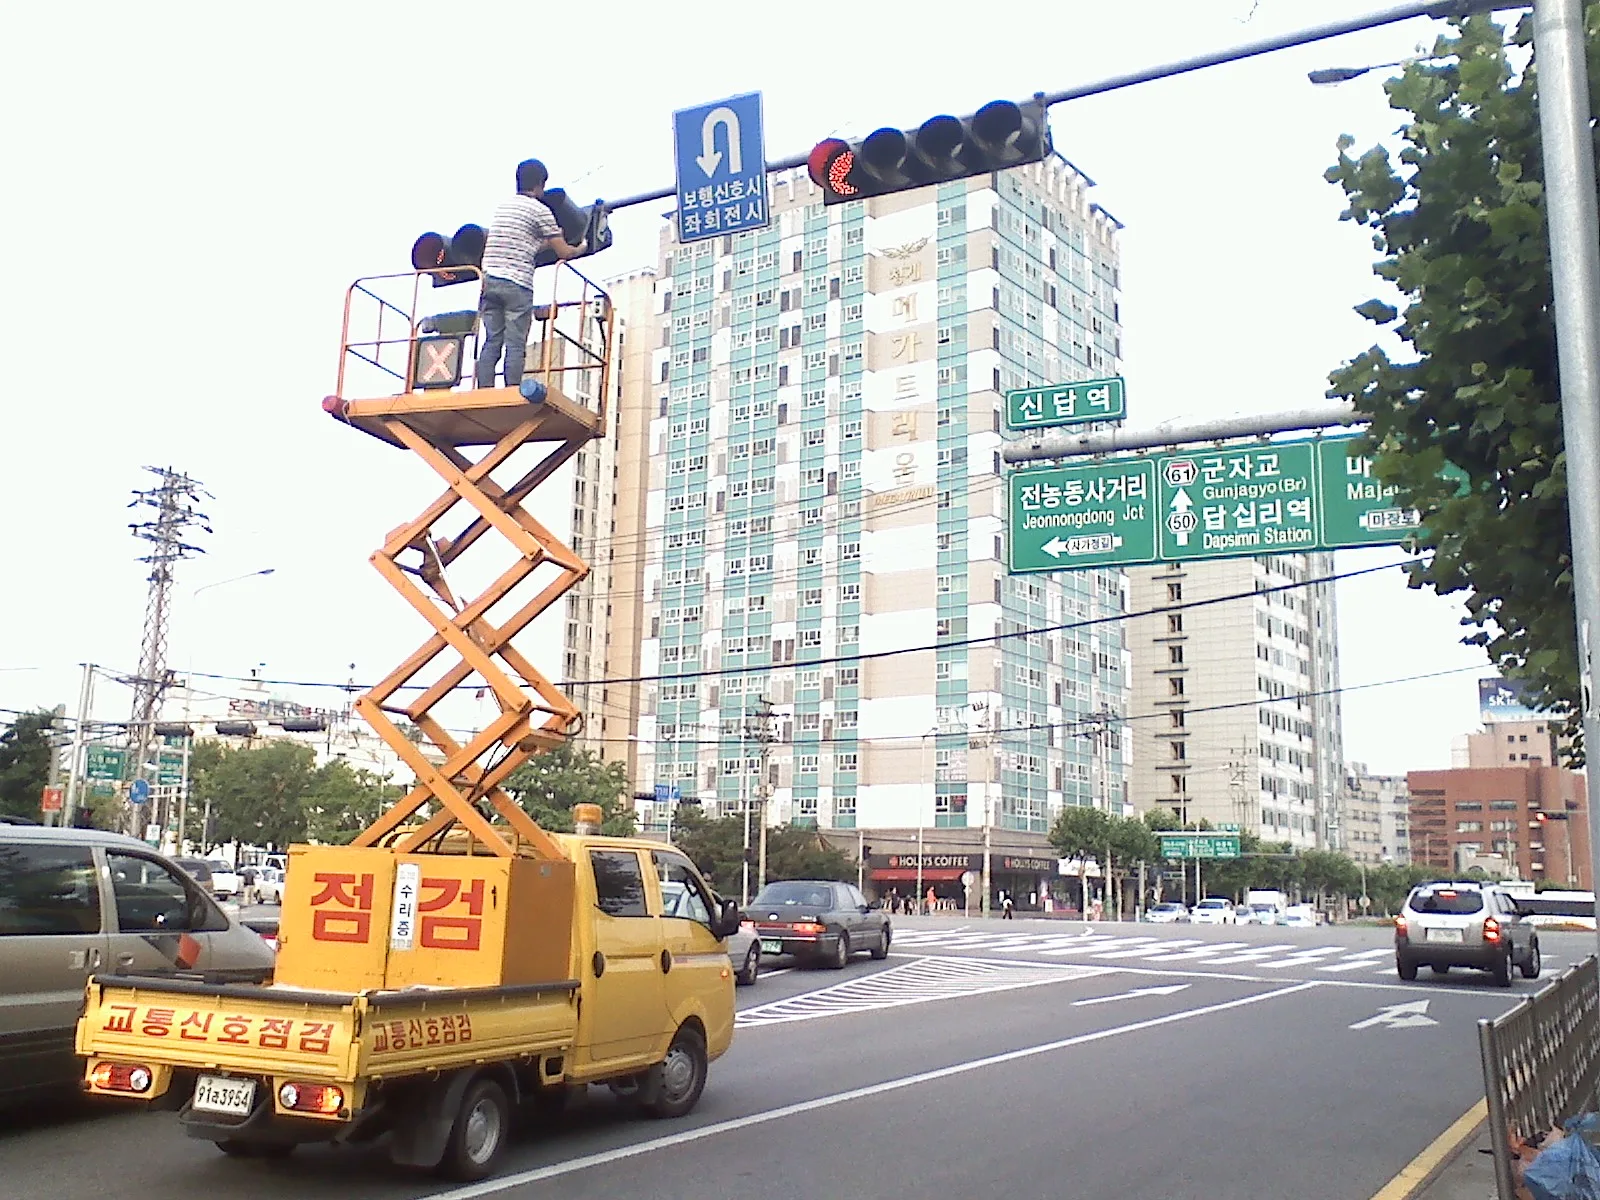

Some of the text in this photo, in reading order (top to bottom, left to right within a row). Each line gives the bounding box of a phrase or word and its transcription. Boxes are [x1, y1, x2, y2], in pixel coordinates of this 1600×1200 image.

[683, 174, 761, 211] 보행신호시
[684, 199, 763, 234] 좌회전시
[1018, 385, 1110, 421] 신답역
[1171, 468, 1190, 482] 61
[1201, 453, 1281, 484] 군자교
[1020, 472, 1147, 511] 전농동사거리
[1022, 504, 1145, 530] Jeonnongdong Jct
[1173, 515, 1191, 530] 50
[1202, 496, 1311, 531] 답십리역
[1202, 526, 1312, 550] Dapsimni Station
[899, 855, 969, 867] HOLYS COFFEE
[102, 1004, 335, 1055] 교통신호점검
[371, 1013, 472, 1052] 교통신호점검
